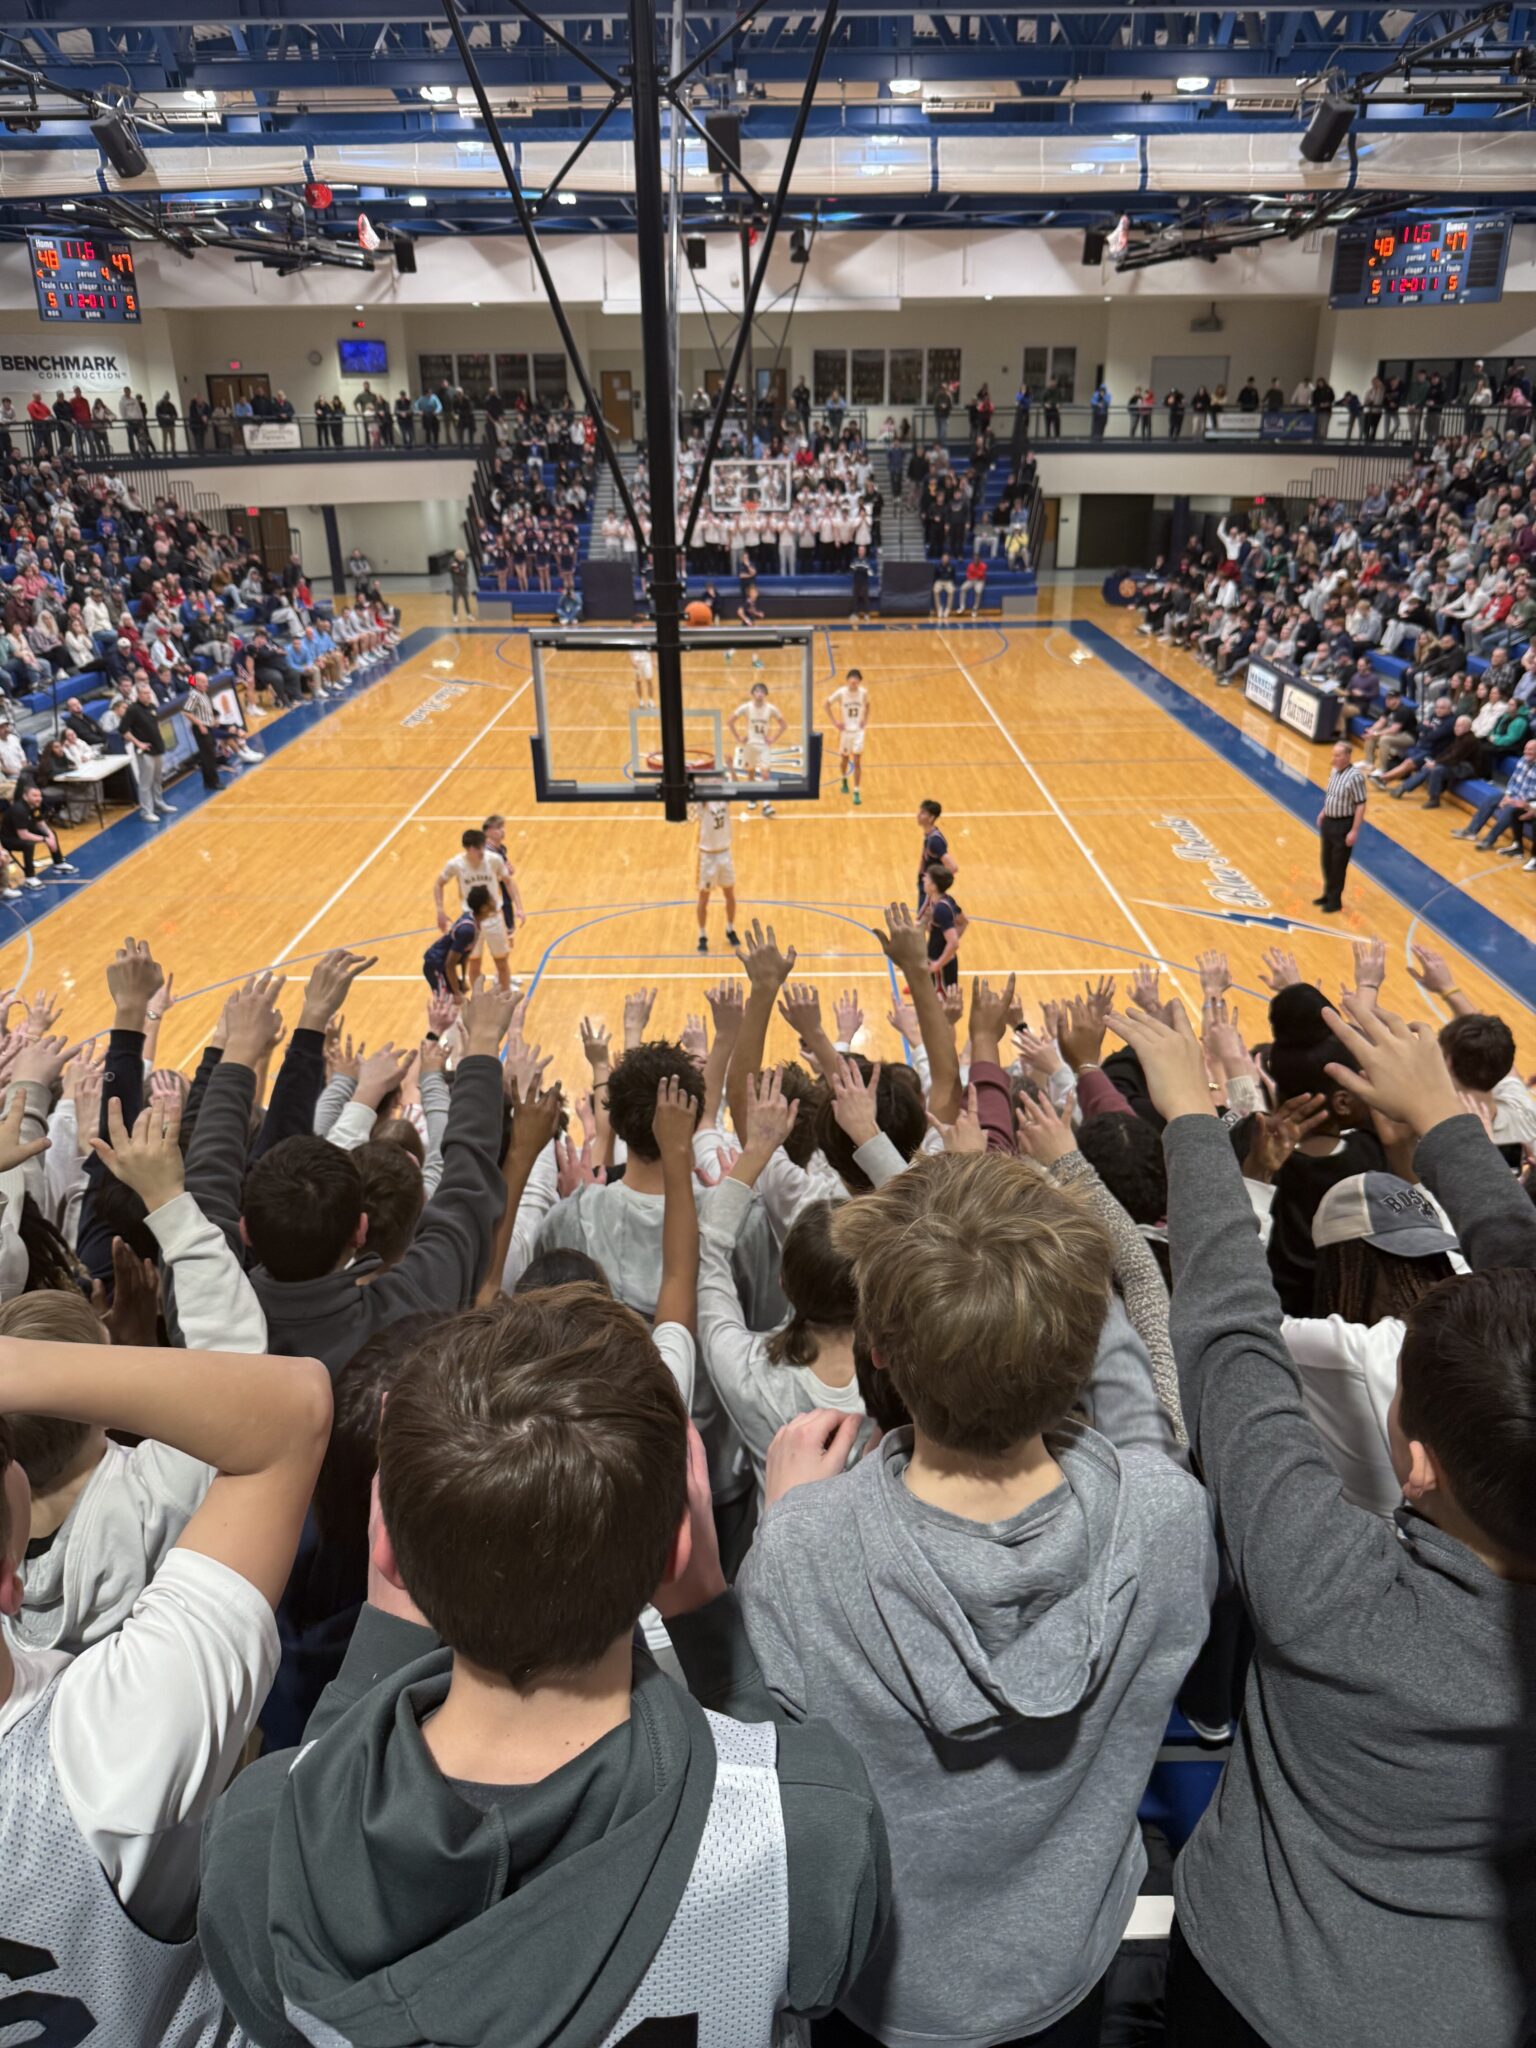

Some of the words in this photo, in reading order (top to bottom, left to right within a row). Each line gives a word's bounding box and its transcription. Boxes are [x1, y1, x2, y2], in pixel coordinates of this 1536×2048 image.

[1403, 223, 1431, 244] 11.6
[1446, 231, 1468, 252] 47
[37, 249, 60, 270] 48
[66, 241, 95, 260] 11.6
[111, 253, 134, 273] 47
[100, 266, 111, 281] 4
[0, 355, 118, 371] BENCHMARK
[38, 371, 121, 380] CONSTRUCTION
[1380, 1187, 1425, 1215] BOS
